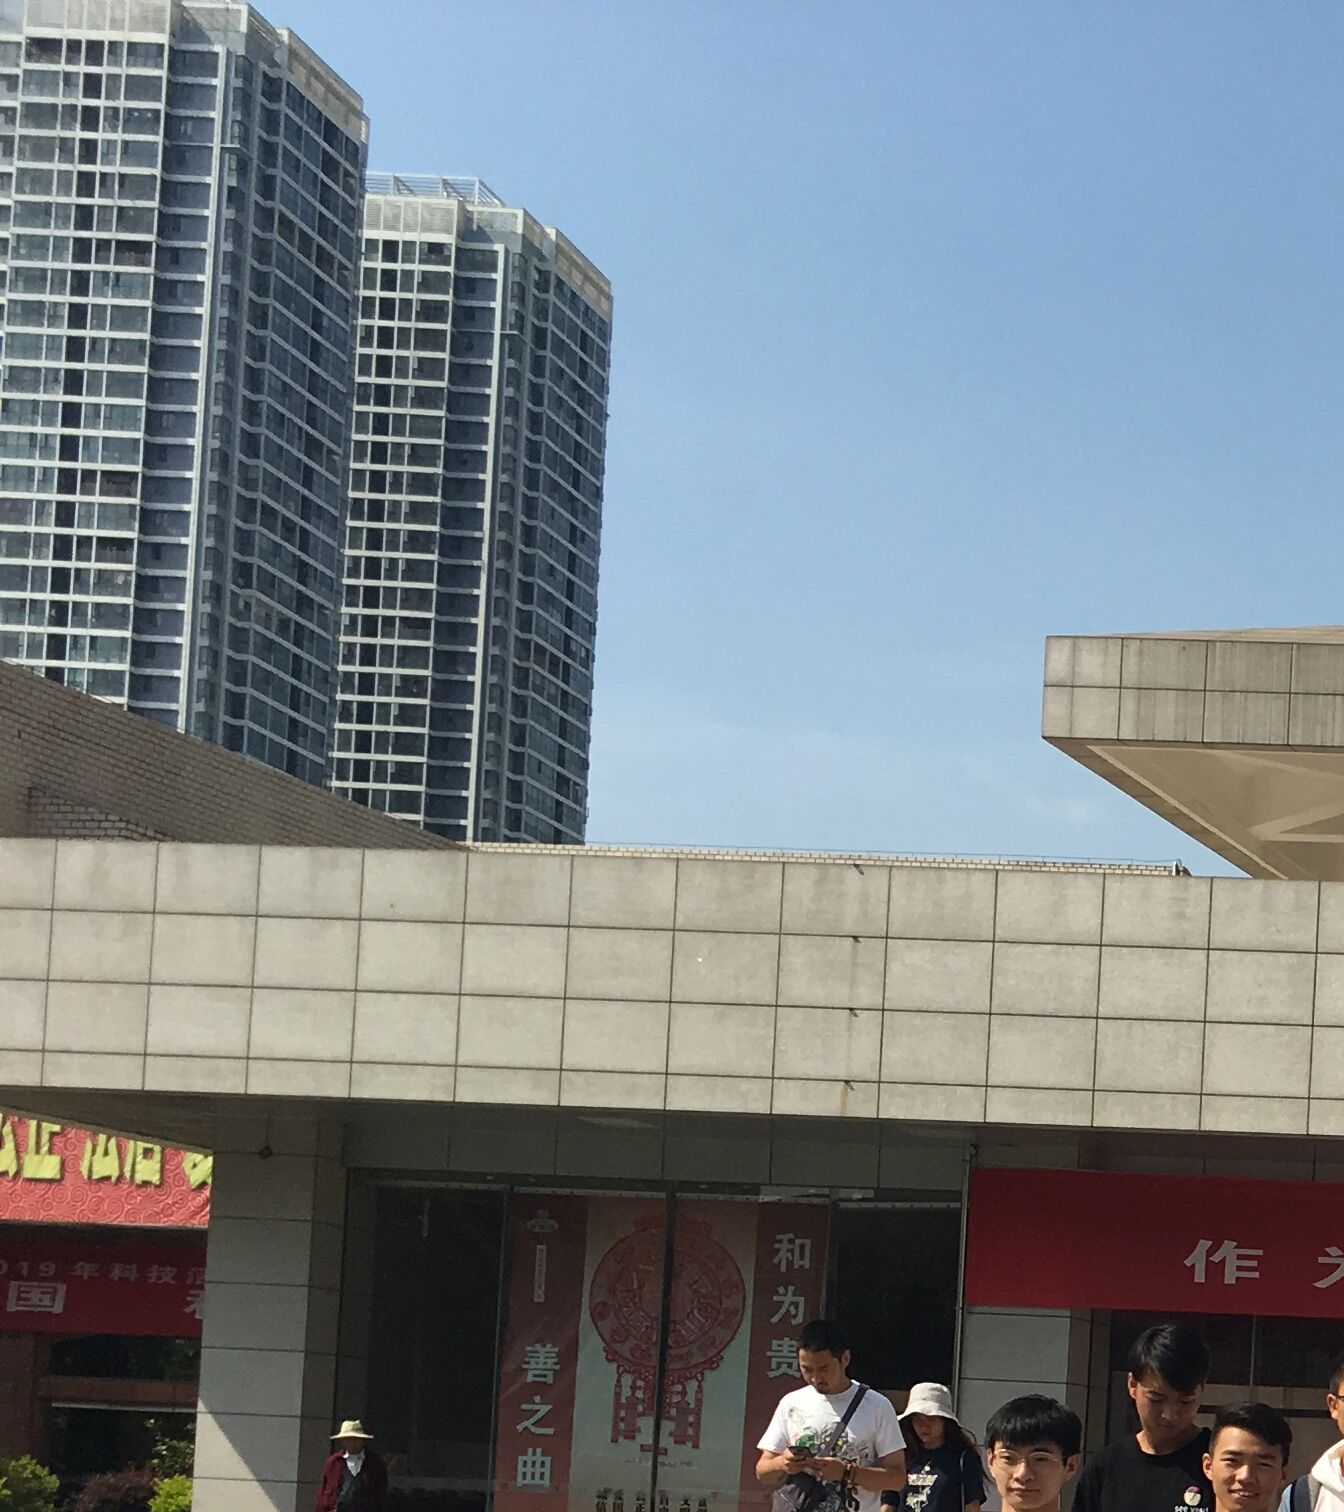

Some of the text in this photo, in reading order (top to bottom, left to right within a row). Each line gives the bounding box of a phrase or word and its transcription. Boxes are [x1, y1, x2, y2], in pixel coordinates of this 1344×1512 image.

[766, 1232, 812, 1379] 和为贵
[516, 1343, 561, 1488] 善之曲
